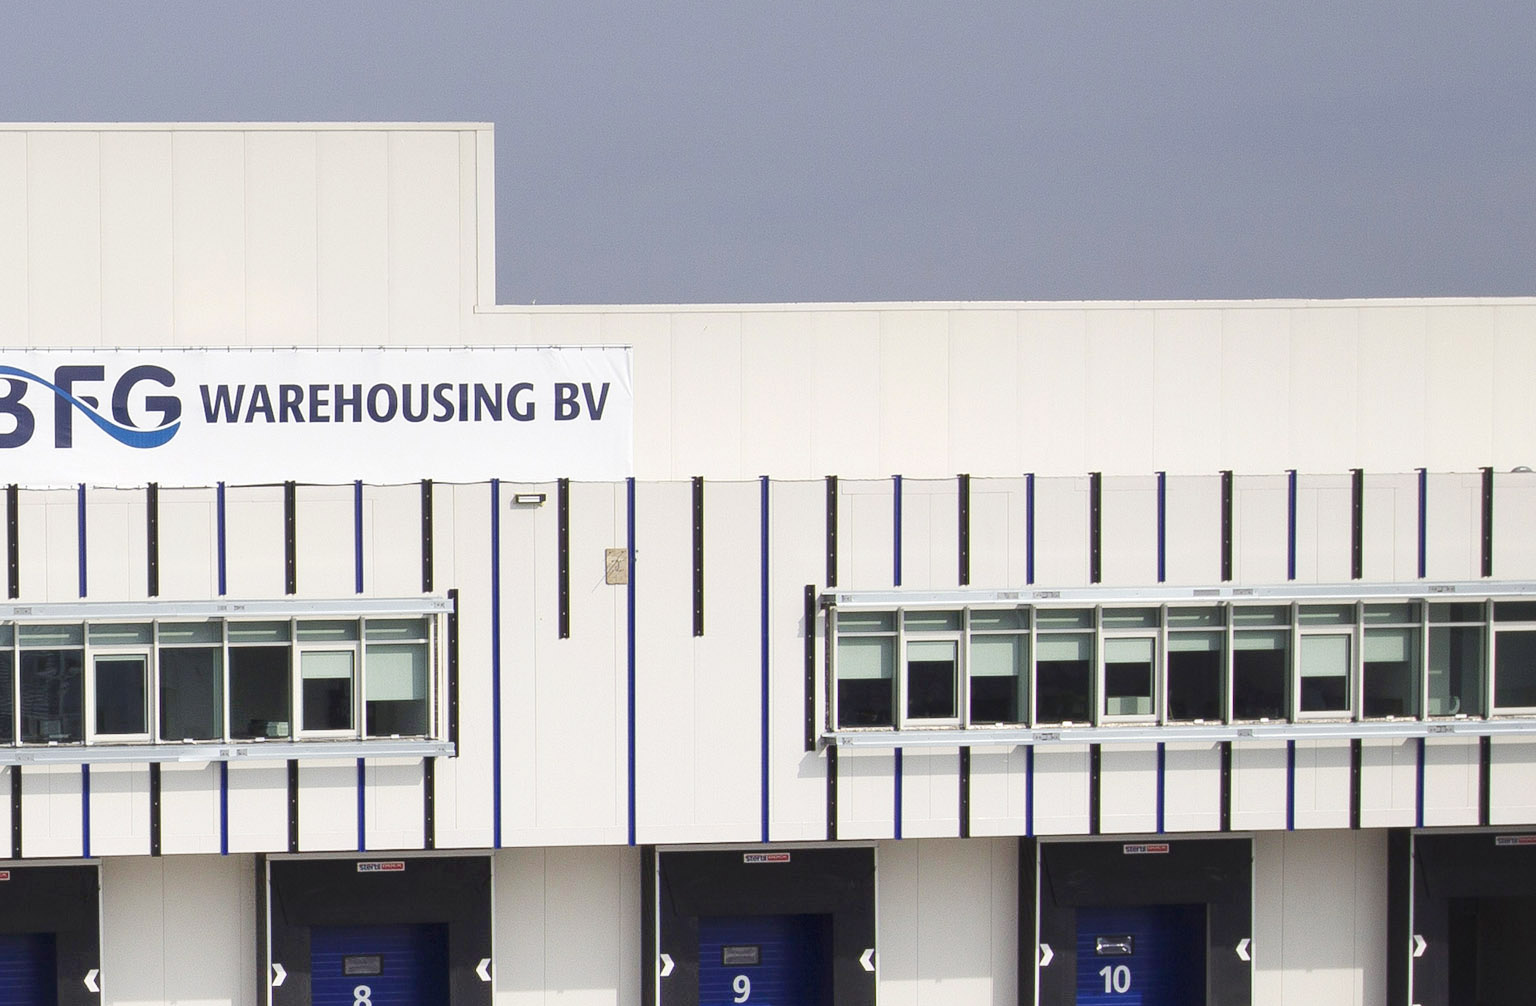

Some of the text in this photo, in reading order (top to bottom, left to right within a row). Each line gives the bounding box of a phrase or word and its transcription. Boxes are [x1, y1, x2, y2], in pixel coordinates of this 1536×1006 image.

[200, 382, 535, 424] WAREHOUSING
[553, 382, 611, 422] BV
[733, 975, 751, 1003] 9
[1099, 965, 1131, 993] 10
